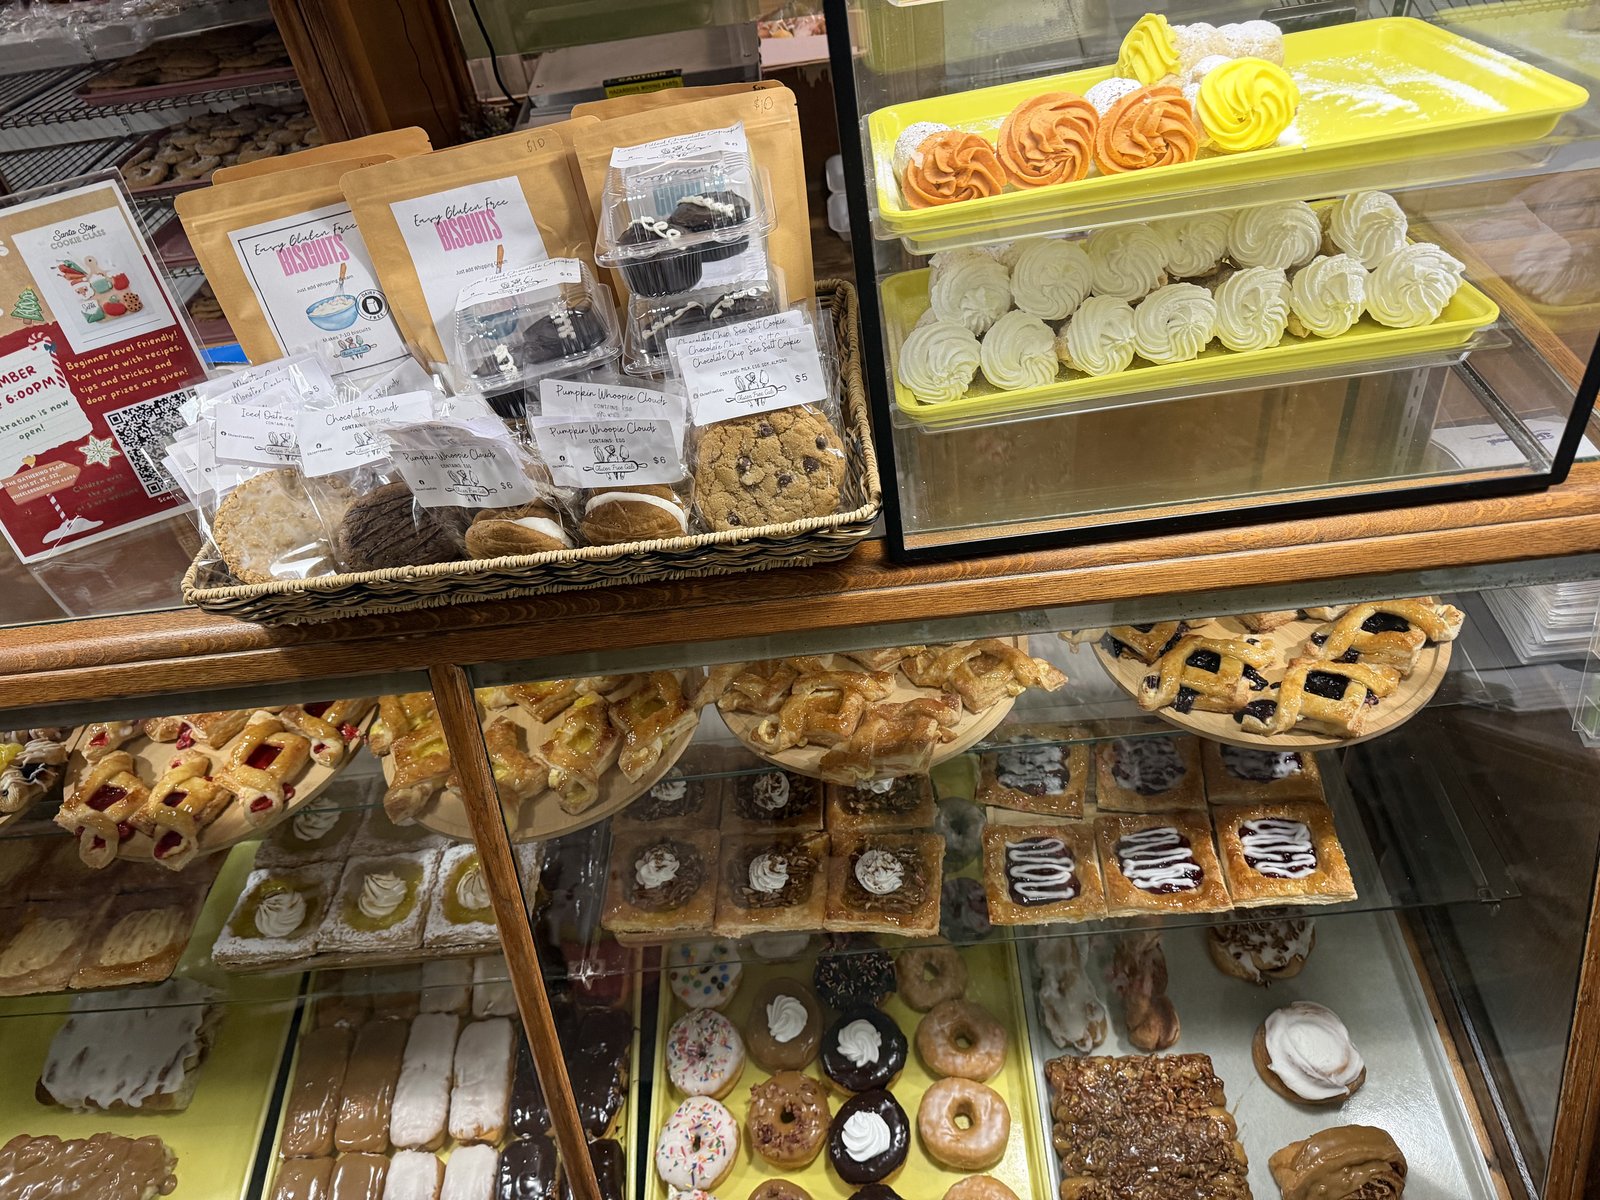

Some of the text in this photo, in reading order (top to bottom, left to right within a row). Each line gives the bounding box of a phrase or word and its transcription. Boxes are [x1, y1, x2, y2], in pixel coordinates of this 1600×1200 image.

[485, 197, 510, 211] Free
[53, 223, 97, 241] Santa Stop
[333, 222, 358, 236] Free
[434, 208, 503, 252] BISCUITS
[50, 229, 107, 250] COOKIE CLASS
[276, 233, 350, 277] BISCUITS
[369, 312, 384, 320] FREE
[763, 317, 787, 331] Cookie
[351, 326, 372, 336] biscuits
[65, 330, 179, 371] Beginner level friendly!
[689, 341, 723, 356] Chocolate
[692, 352, 727, 368] Chocolate
[726, 348, 745, 361] Chip
[747, 344, 762, 356] Sea
[761, 339, 776, 353] Salt
[777, 337, 802, 350] Cookie
[72, 344, 183, 383] You leave with recipes,
[79, 359, 173, 394] tips and tricks, and
[794, 372, 808, 383] $5
[5, 376, 56, 404] 6:00PM
[86, 367, 189, 406] door prizes are given!
[556, 384, 667, 406] Pumpkin Whoopie Clouds
[37, 409, 48, 417] is
[49, 399, 69, 412] now
[241, 407, 261, 420] Iced
[326, 406, 368, 425] Chocolate
[368, 401, 400, 417] Rounds
[18, 423, 46, 441] open!
[550, 422, 657, 440] Pumpkin Whoopie Clouds
[652, 456, 666, 465] $6
[6, 462, 67, 488] THE GATHERING PLACE
[500, 481, 513, 490] $6
